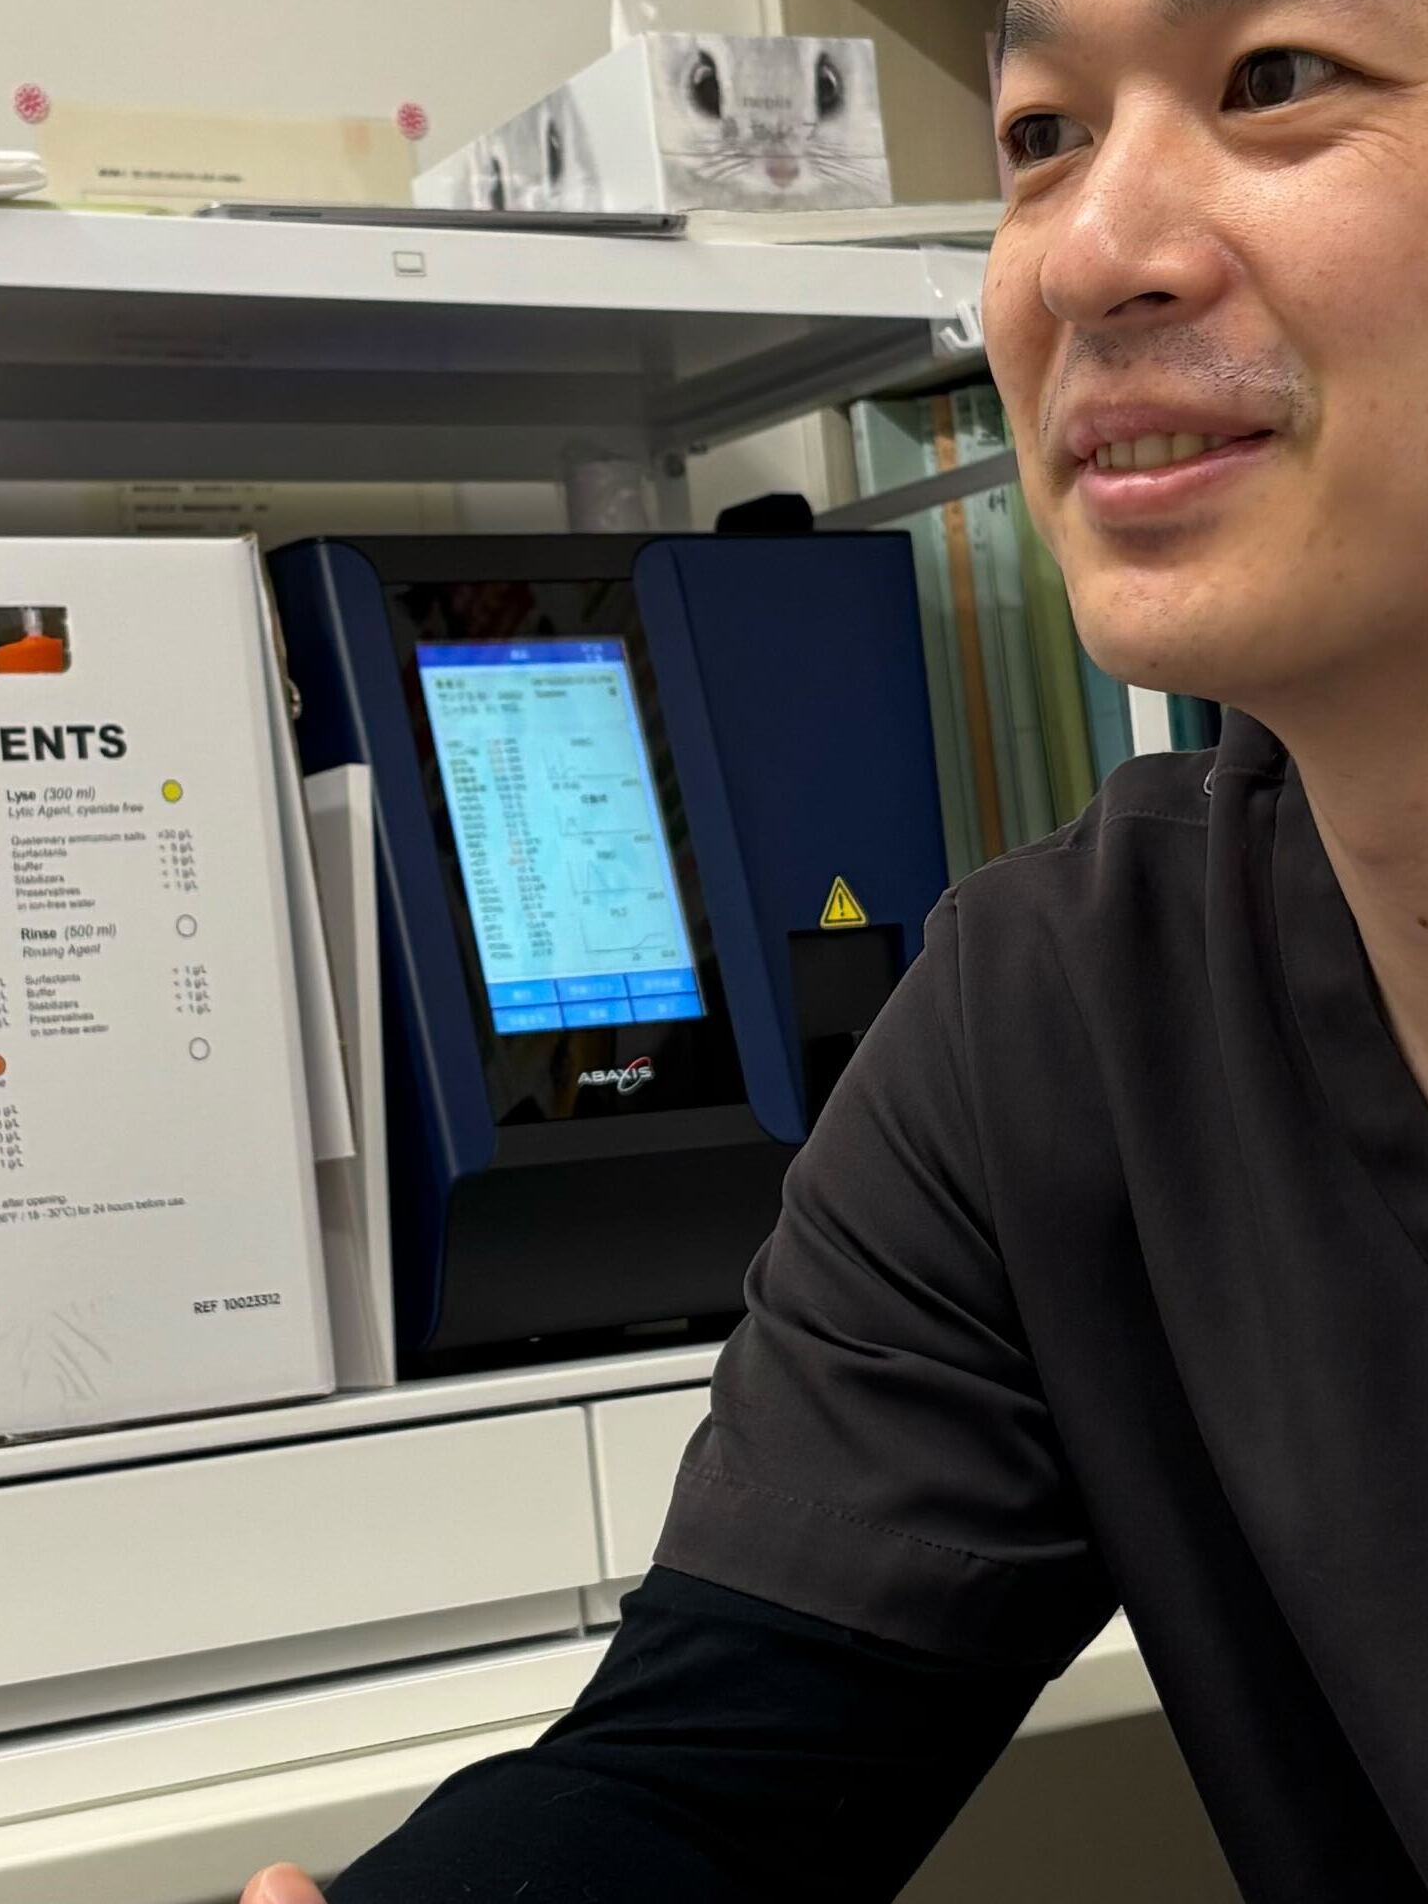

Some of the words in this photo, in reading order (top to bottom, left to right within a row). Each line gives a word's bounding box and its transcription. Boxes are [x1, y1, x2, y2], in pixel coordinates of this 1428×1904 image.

[6, 789, 36, 804] Lyse
[43, 787, 72, 803] (300
[75, 786, 96, 801] ml)
[122, 802, 144, 813] free
[21, 927, 57, 941] Rinse
[63, 924, 93, 941] (500
[97, 923, 118, 939] ml)
[68, 943, 102, 958] Agent
[576, 1058, 656, 1091] ABAXIS
[193, 1299, 219, 1316] REF
